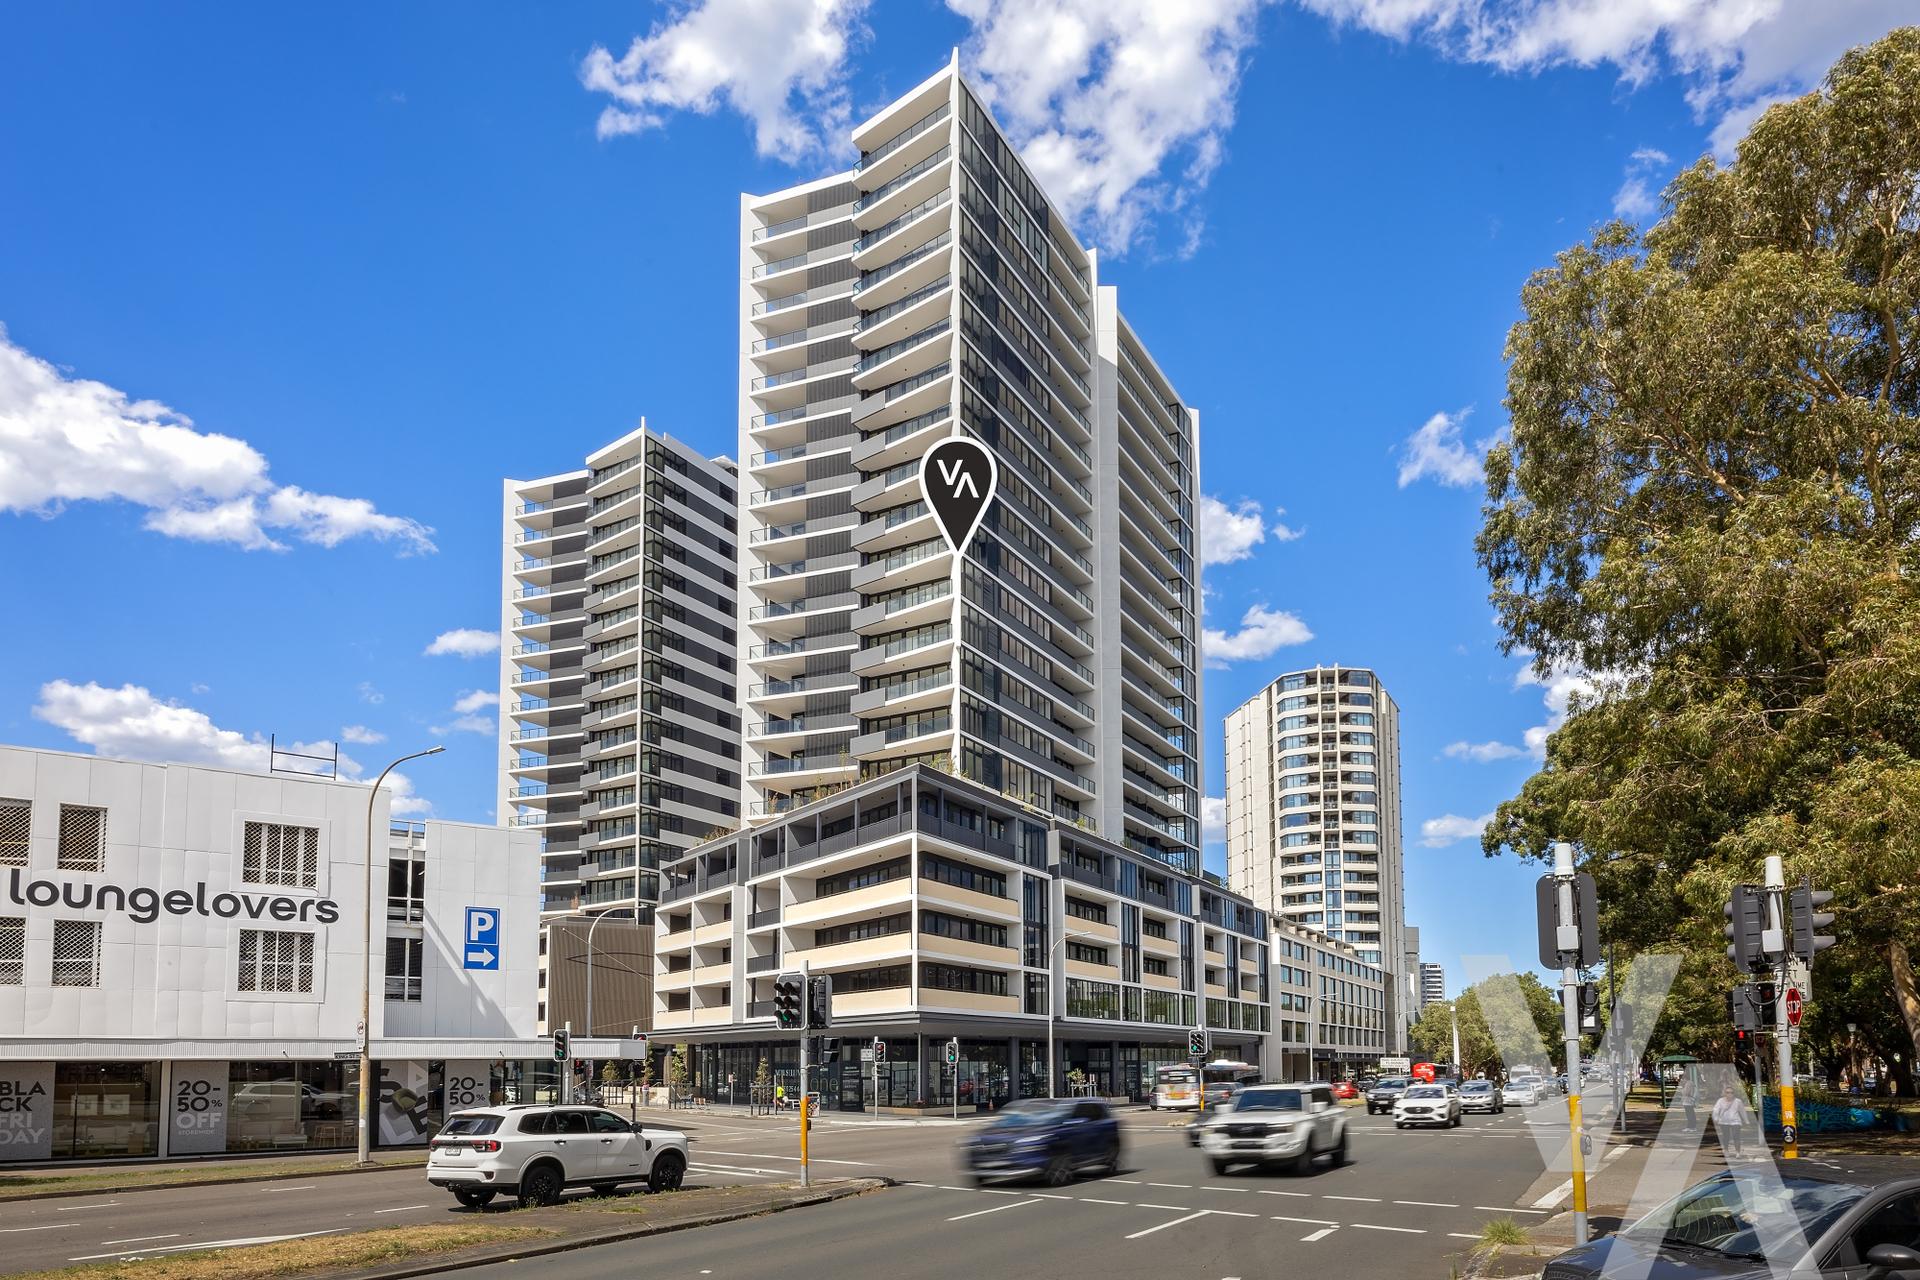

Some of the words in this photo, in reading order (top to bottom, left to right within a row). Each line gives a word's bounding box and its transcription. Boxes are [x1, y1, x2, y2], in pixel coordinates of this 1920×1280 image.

[9, 868, 340, 924] loungelovers
[470, 911, 495, 941] P
[1787, 1000, 1800, 1014] STOP
[0, 1081, 46, 1096] BLA
[177, 1080, 221, 1096] 20-
[449, 1077, 484, 1091] 20-
[0, 1096, 32, 1112] CK
[177, 1096, 224, 1112] 50%
[449, 1091, 486, 1105] 50%
[176, 1112, 222, 1129] OFF
